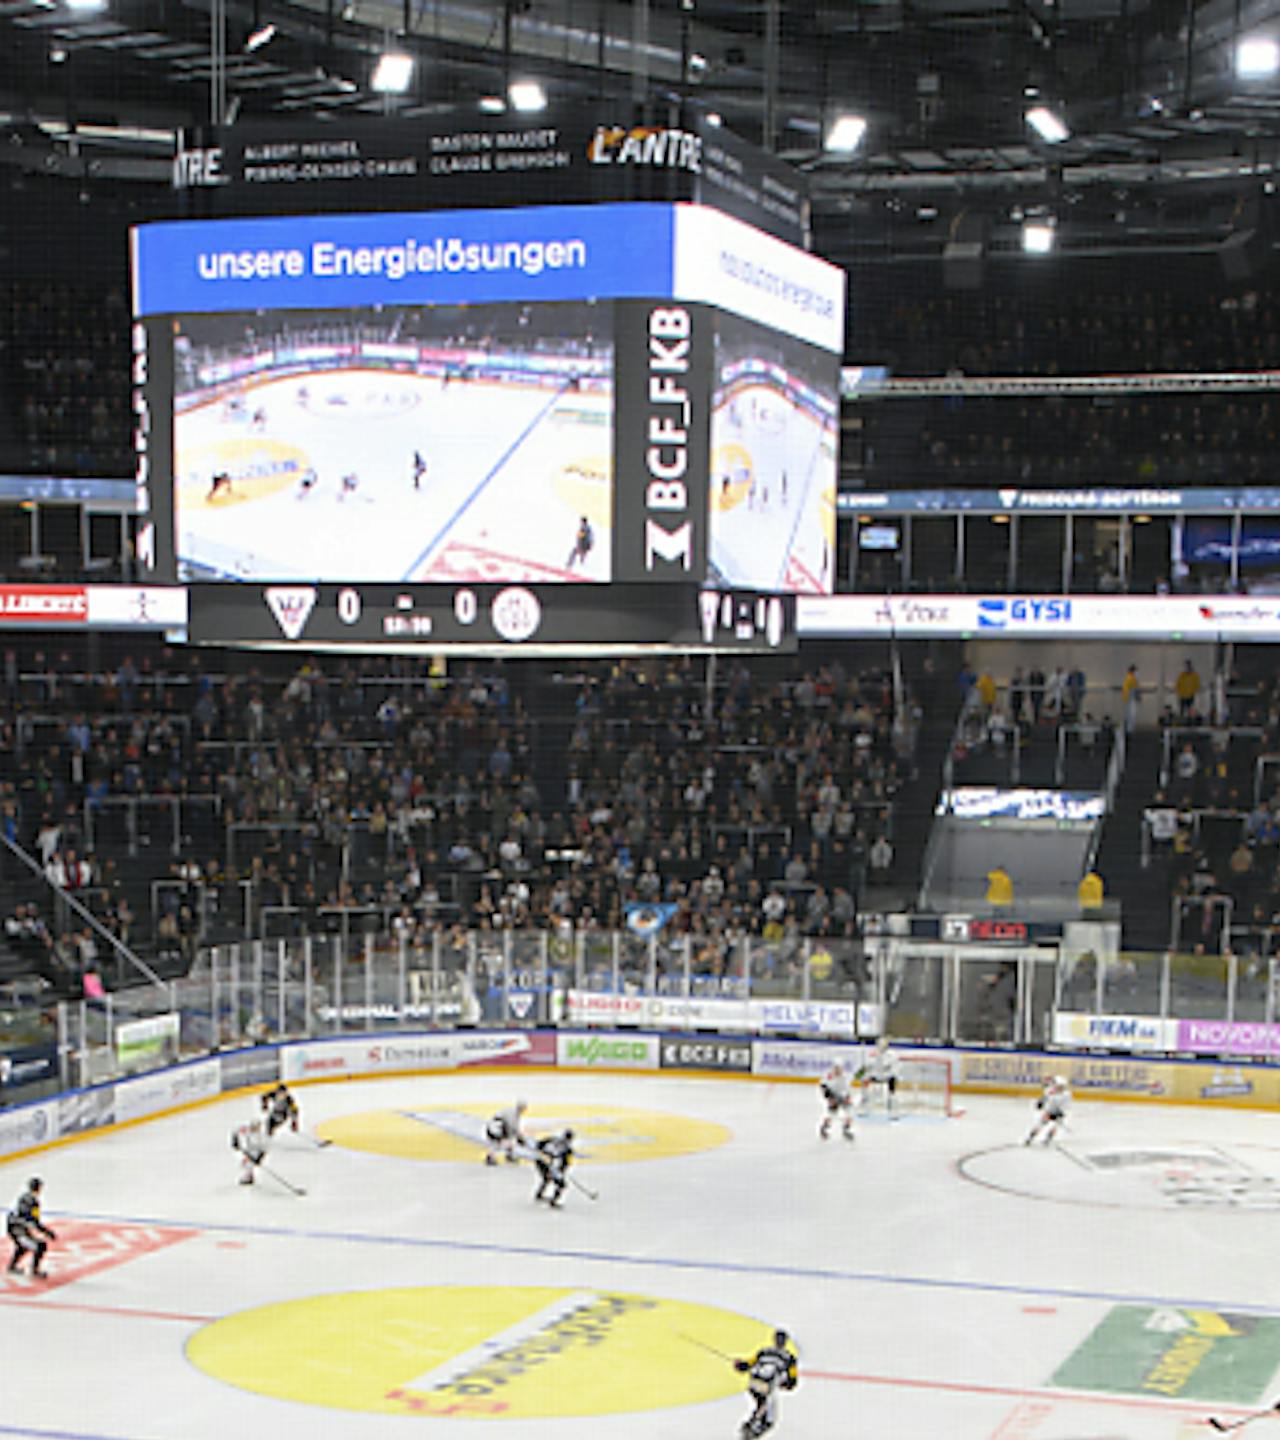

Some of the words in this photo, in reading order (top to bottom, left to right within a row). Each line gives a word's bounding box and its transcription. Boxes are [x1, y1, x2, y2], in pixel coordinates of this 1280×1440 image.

[199, 247, 304, 280] unsere
[312, 237, 586, 282] Energielösungen
[646, 305, 691, 511] BCF_FKB
[338, 589, 361, 625] 0
[454, 589, 477, 625] 0
[1011, 599, 1072, 621] GYSI
